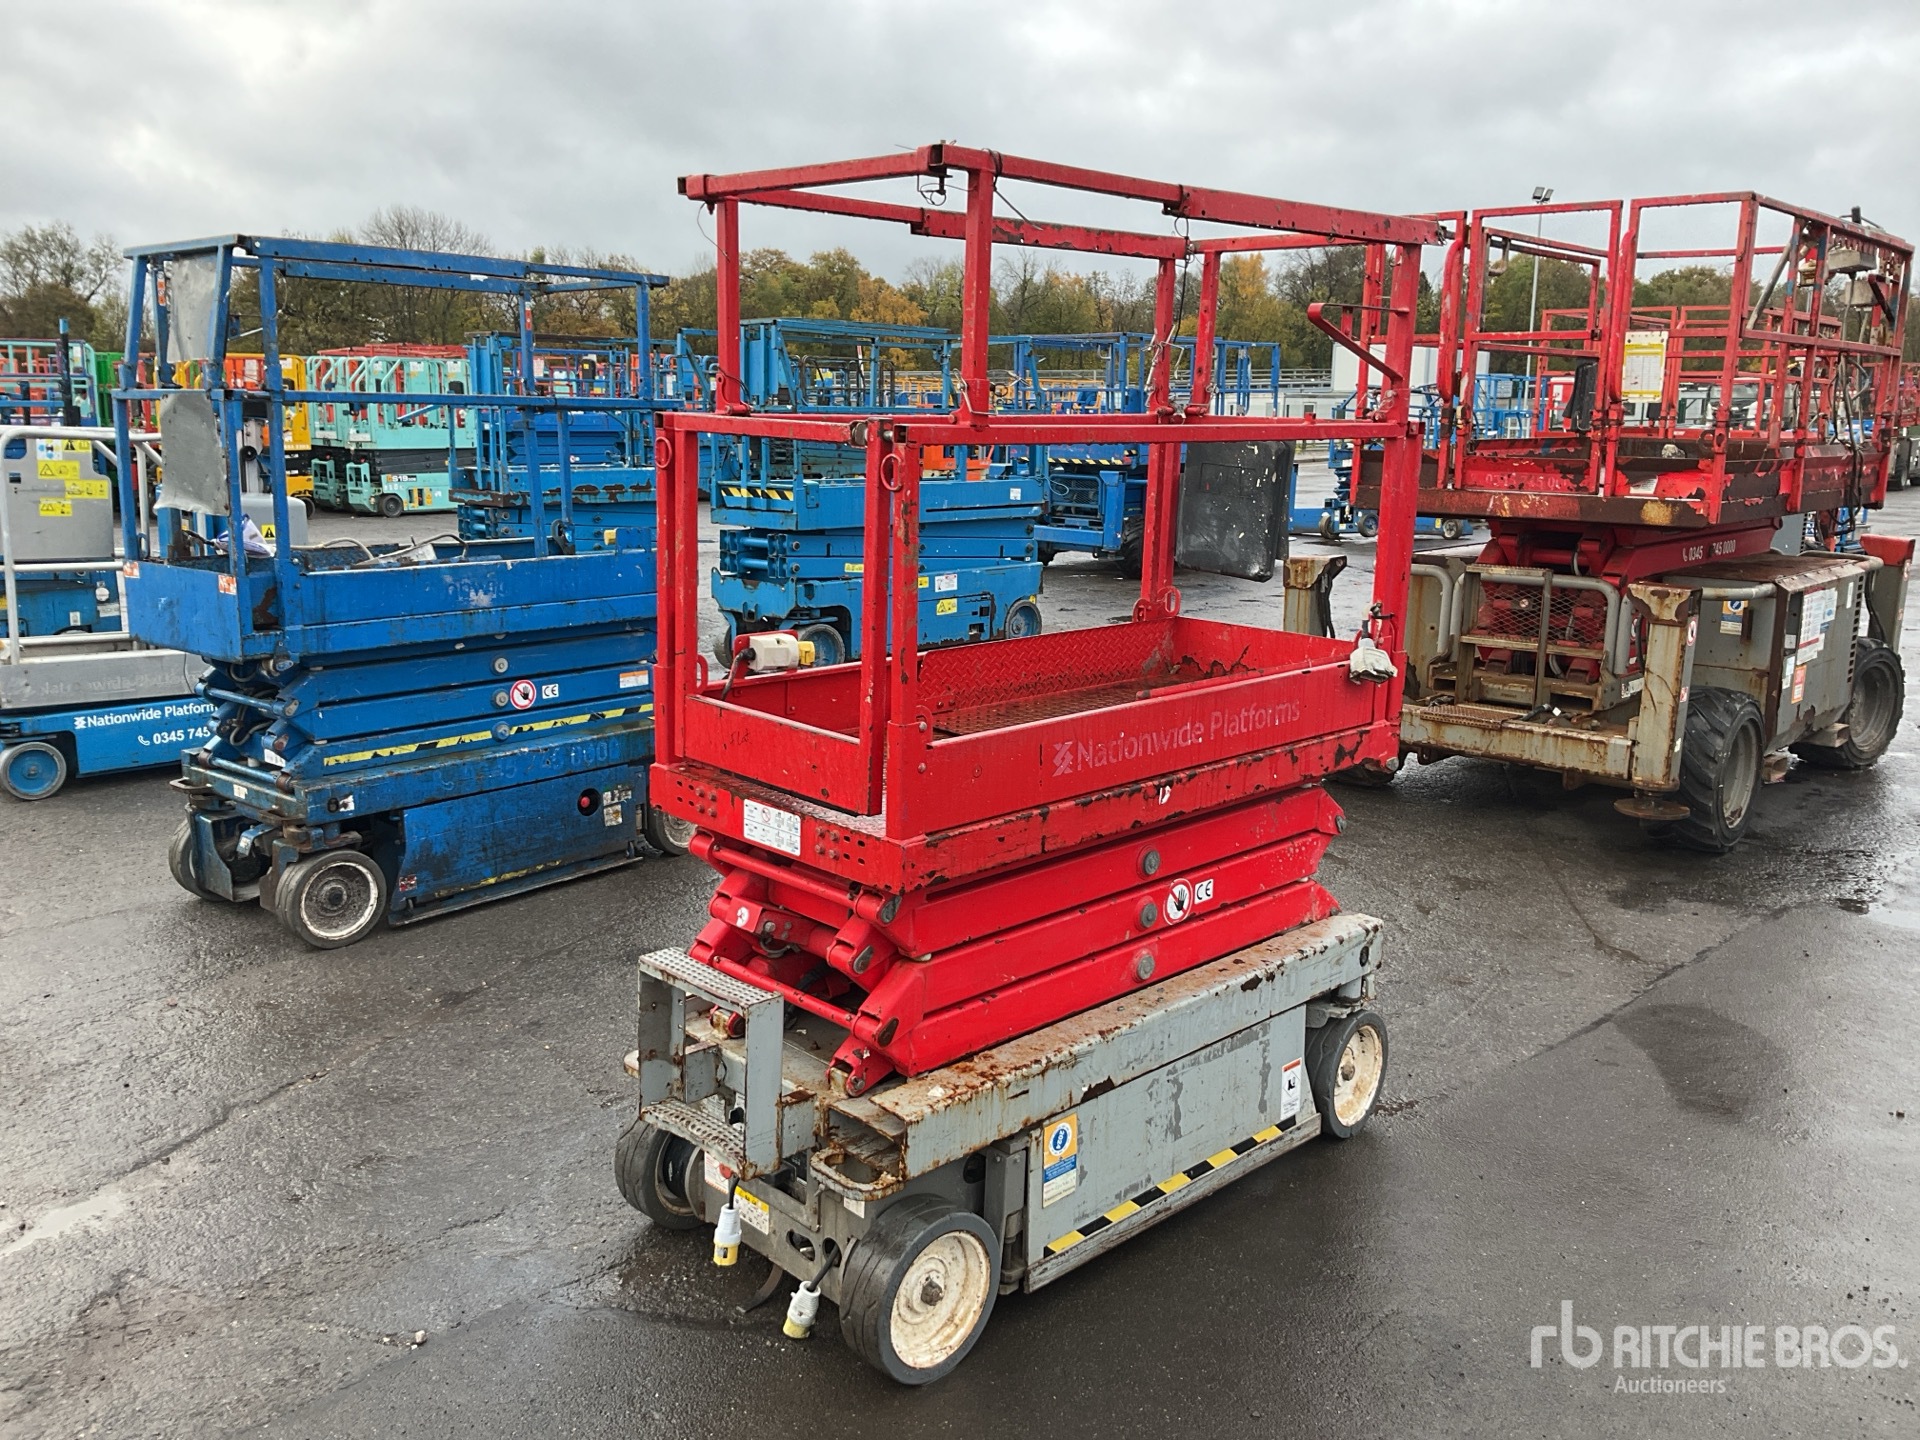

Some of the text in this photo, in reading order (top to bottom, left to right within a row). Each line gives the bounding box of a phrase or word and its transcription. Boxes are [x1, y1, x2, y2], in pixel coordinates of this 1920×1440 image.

[1688, 545, 1704, 561] 0345
[543, 685, 558, 697] CE
[87, 702, 219, 727] Nationwide Platform
[153, 726, 211, 745] 0345 745
[1076, 700, 1301, 771] Nationwide Platforms
[1196, 880, 1213, 900] CE
